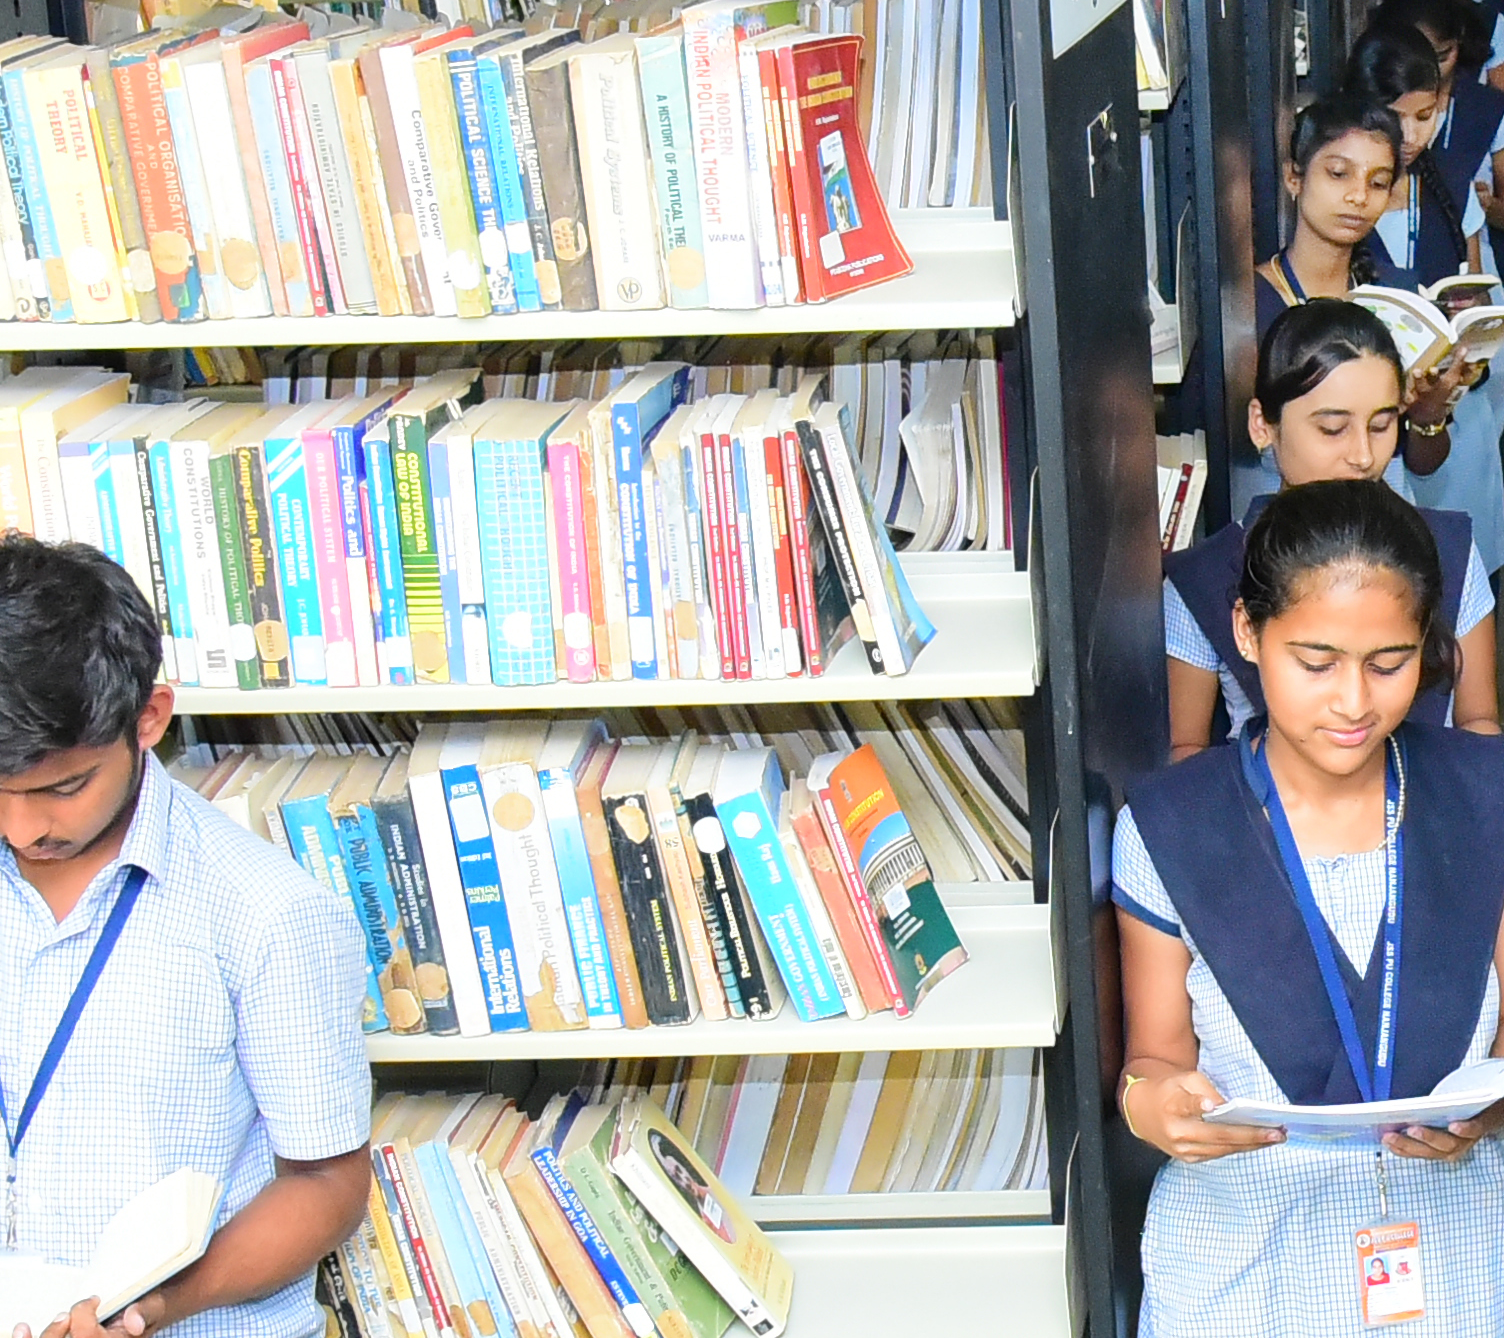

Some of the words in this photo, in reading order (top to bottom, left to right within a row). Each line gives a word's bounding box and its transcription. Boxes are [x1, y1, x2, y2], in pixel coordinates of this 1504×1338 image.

[693, 29, 712, 79] INDIAN
[46, 101, 67, 154] THEORY
[63, 90, 88, 161] POLITICAL
[457, 73, 482, 143] POLITICAL
[472, 144, 492, 211] SCIENCE
[657, 105, 673, 149] HISTORY
[696, 81, 715, 154] POLITICAL
[715, 92, 734, 156] MODERN
[0, 127, 20, 179] Political
[10, 179, 29, 225] Theory
[146, 144, 158, 169] AND
[410, 110, 435, 201] Comparative
[664, 152, 676, 164] OF
[407, 160, 419, 184] and
[415, 187, 429, 239] Politics
[666, 168, 684, 223] POLITICAL
[702, 159, 722, 225] THOUGHT
[708, 234, 745, 242] VARMA
[315, 452, 323, 472] OUR
[809, 448, 824, 470] THE
[183, 447, 206, 560] CONSTITUTIONS
[200, 476, 214, 525] WORLD
[237, 448, 257, 535] Comparative
[250, 536, 265, 588] Politics
[276, 492, 294, 545] POLITICAL
[317, 473, 332, 529] POLITICAL
[340, 475, 356, 526] Politics
[406, 452, 428, 553] CONSTITUTIONAL
[815, 471, 840, 530] CONSUMER
[218, 487, 232, 531] HISTORY
[227, 546, 242, 599] POLITICAL
[282, 546, 296, 588] THEORY
[291, 498, 310, 581] CONTEMPORARY
[324, 530, 337, 564] SYSTEM
[346, 529, 364, 557] and
[835, 531, 862, 597] PROTECTION
[1386, 799, 1395, 816] JSS
[518, 833, 540, 903] Thought
[1387, 831, 1397, 863] COLLEGE
[390, 824, 407, 860] INDIAN
[399, 864, 427, 949] ADMINISTRATION
[535, 904, 554, 960] Political
[651, 899, 665, 932] SYSTEM
[473, 926, 502, 1015] International
[657, 933, 672, 974] POLITICAL
[689, 919, 715, 981] Parliament
[768, 914, 802, 994] GOVERNMENT
[1386, 941, 1394, 957] JSS
[498, 947, 522, 1014] Relations
[664, 974, 677, 1002] INDIAN
[703, 984, 719, 1007] Our
[1382, 970, 1394, 1009] COLLEGE
[542, 1149, 569, 1195] POLITICS
[560, 1187, 585, 1215] AND
[576, 1209, 608, 1261] POLITICAL
